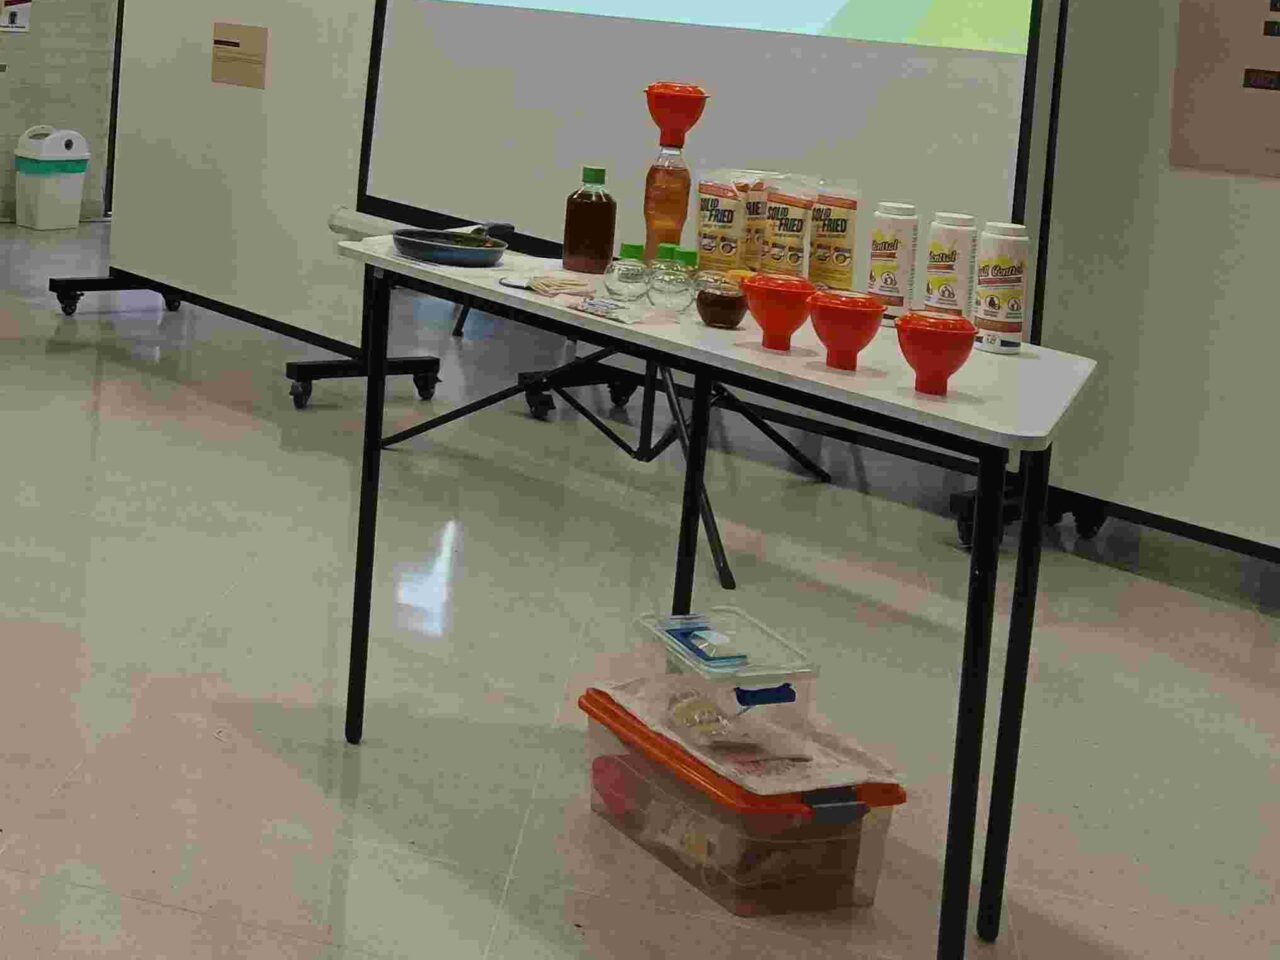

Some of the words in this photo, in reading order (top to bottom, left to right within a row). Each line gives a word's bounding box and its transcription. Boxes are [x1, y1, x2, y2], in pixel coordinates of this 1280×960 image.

[707, 208, 735, 224] FRIED
[778, 218, 803, 233] FRIED
[822, 218, 847, 233] FRIED
